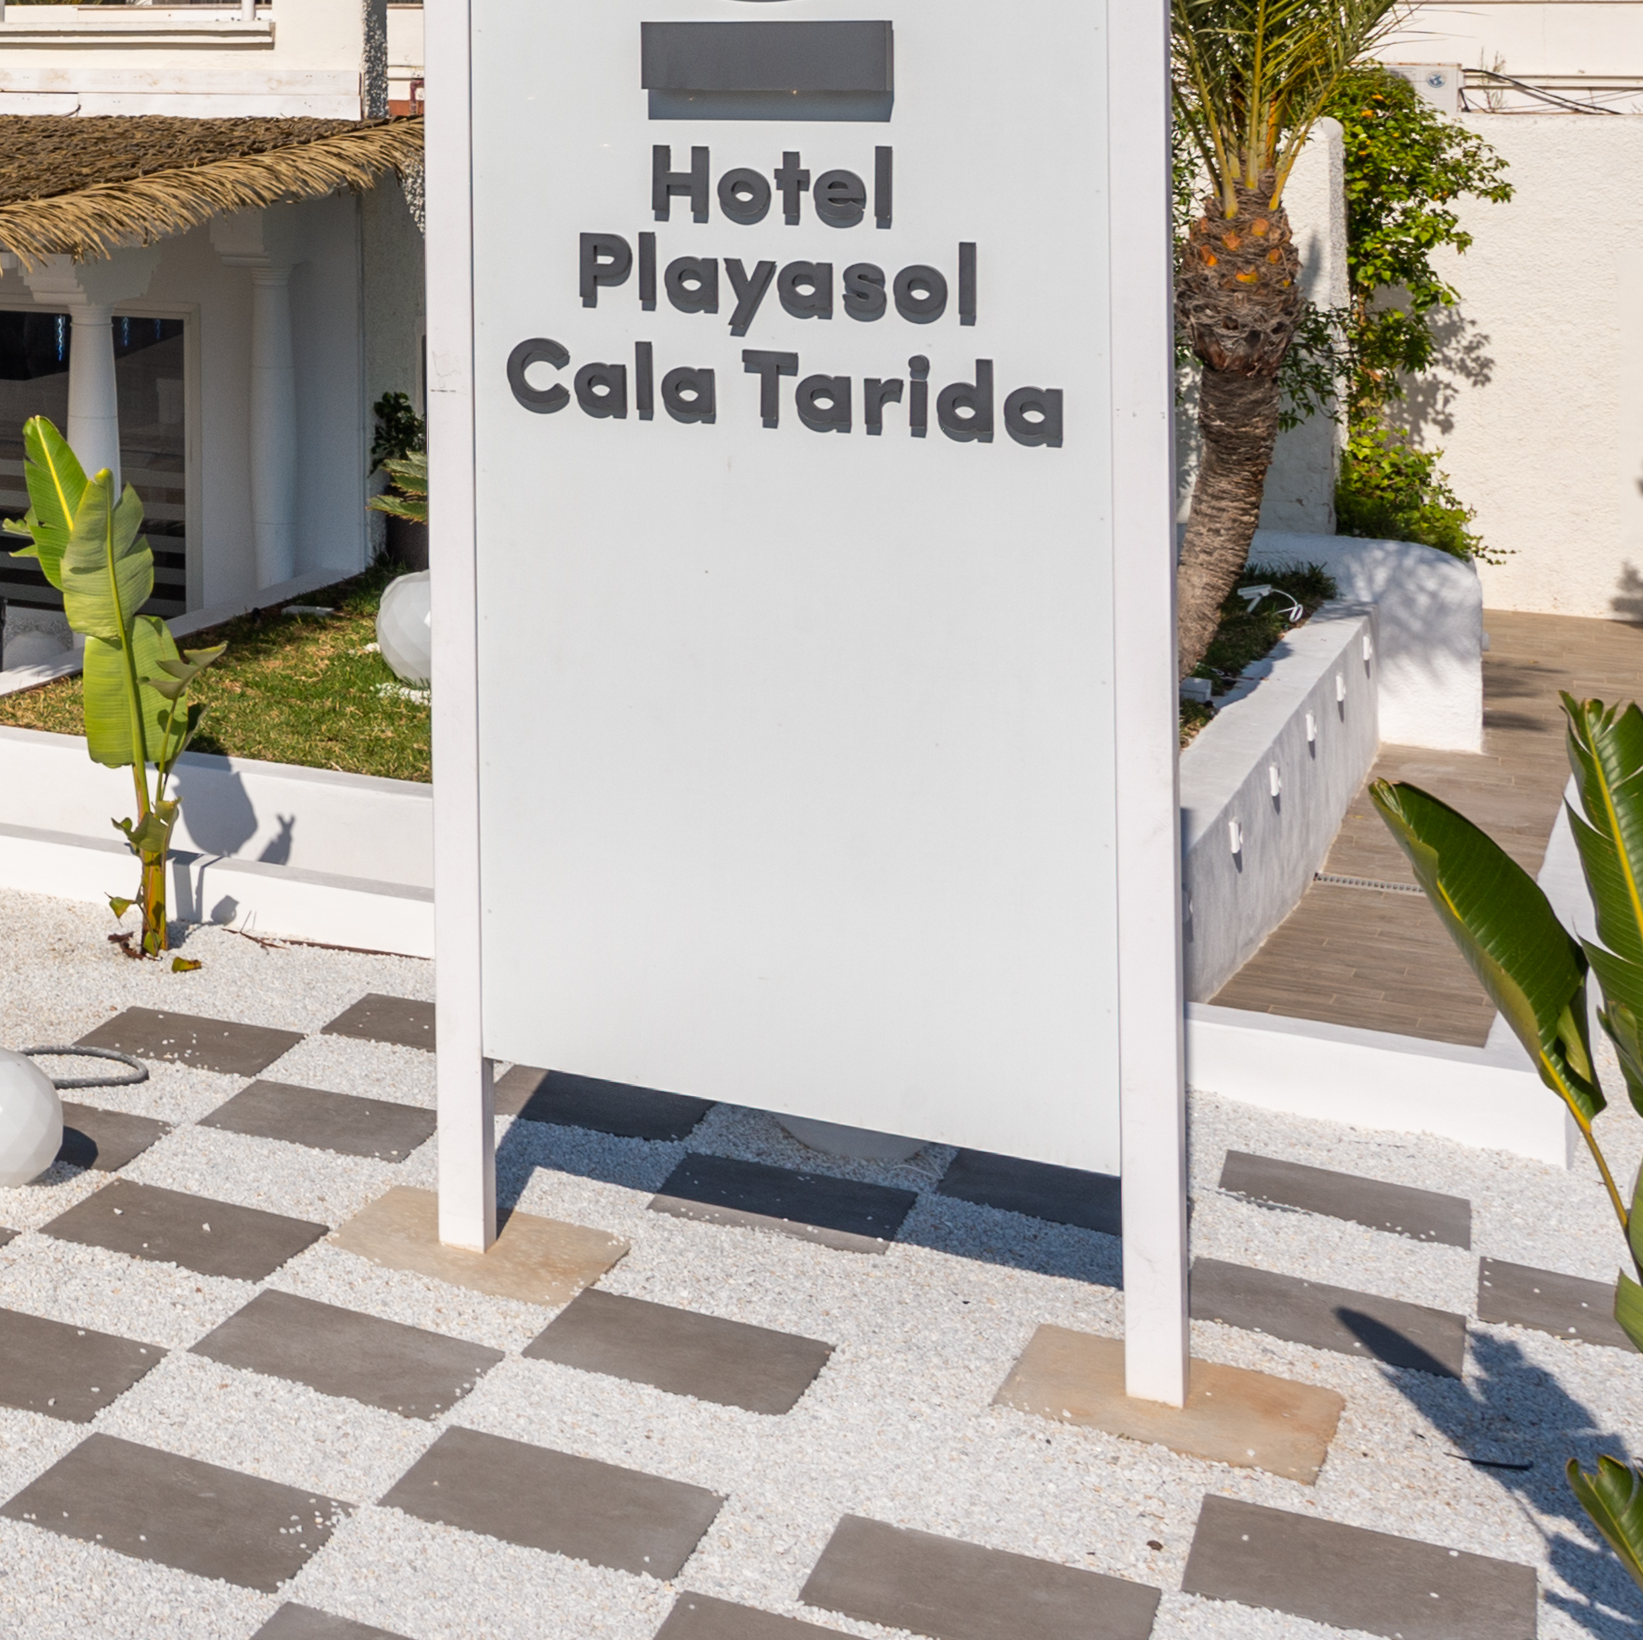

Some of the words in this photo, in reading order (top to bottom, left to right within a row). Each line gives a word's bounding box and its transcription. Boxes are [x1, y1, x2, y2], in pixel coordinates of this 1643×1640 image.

[651, 144, 893, 224] Hotel
[578, 231, 977, 334] Playasol
[506, 337, 717, 420] Cala
[741, 348, 1064, 444] Tarida
